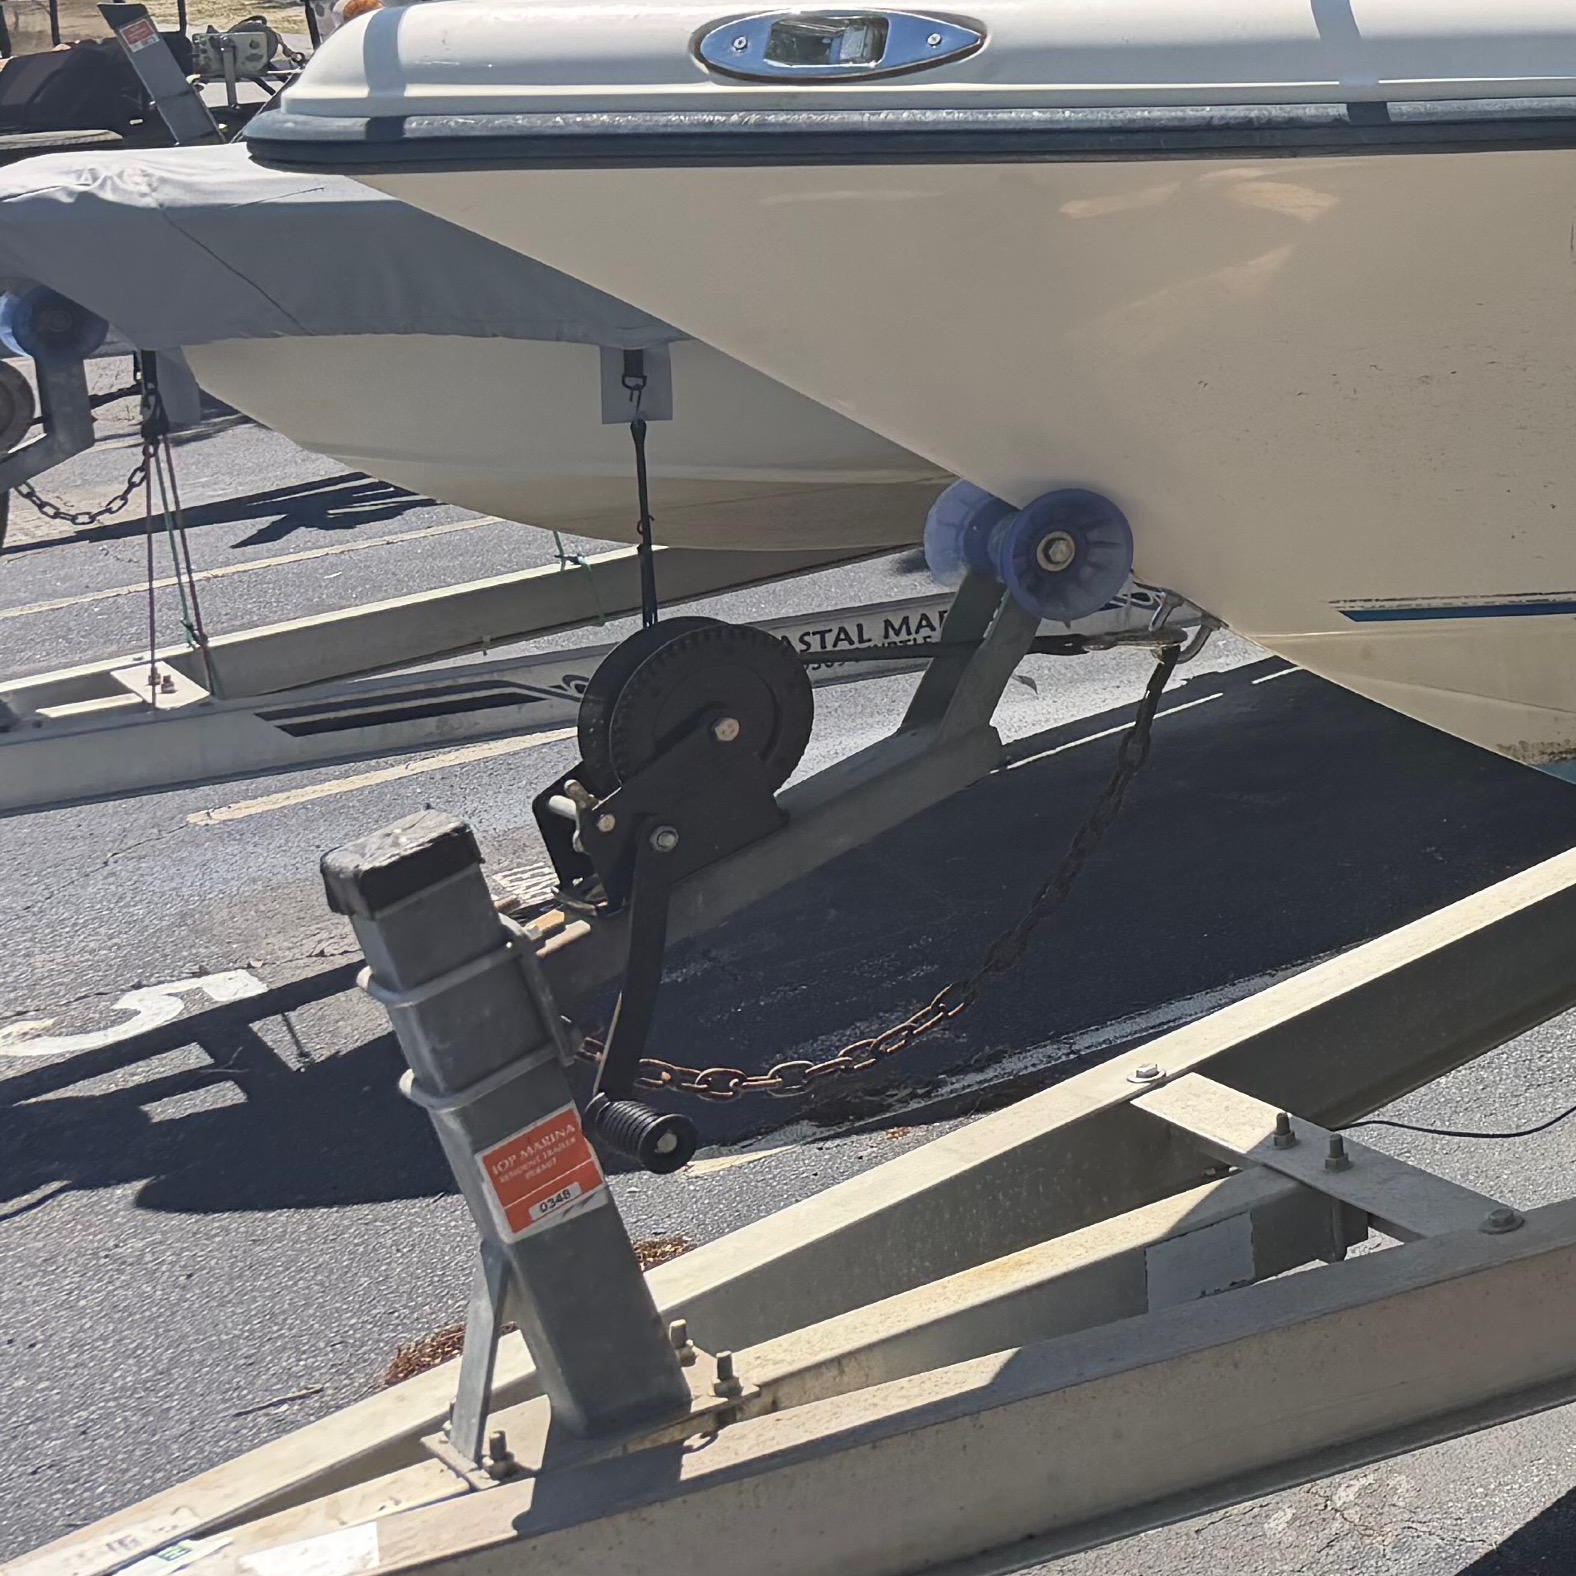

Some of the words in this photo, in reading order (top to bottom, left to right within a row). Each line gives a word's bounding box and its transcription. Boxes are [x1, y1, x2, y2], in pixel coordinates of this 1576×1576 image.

[780, 622, 872, 653] ASTAL
[491, 1154, 517, 1175] IOP
[519, 1124, 576, 1159] MARINA
